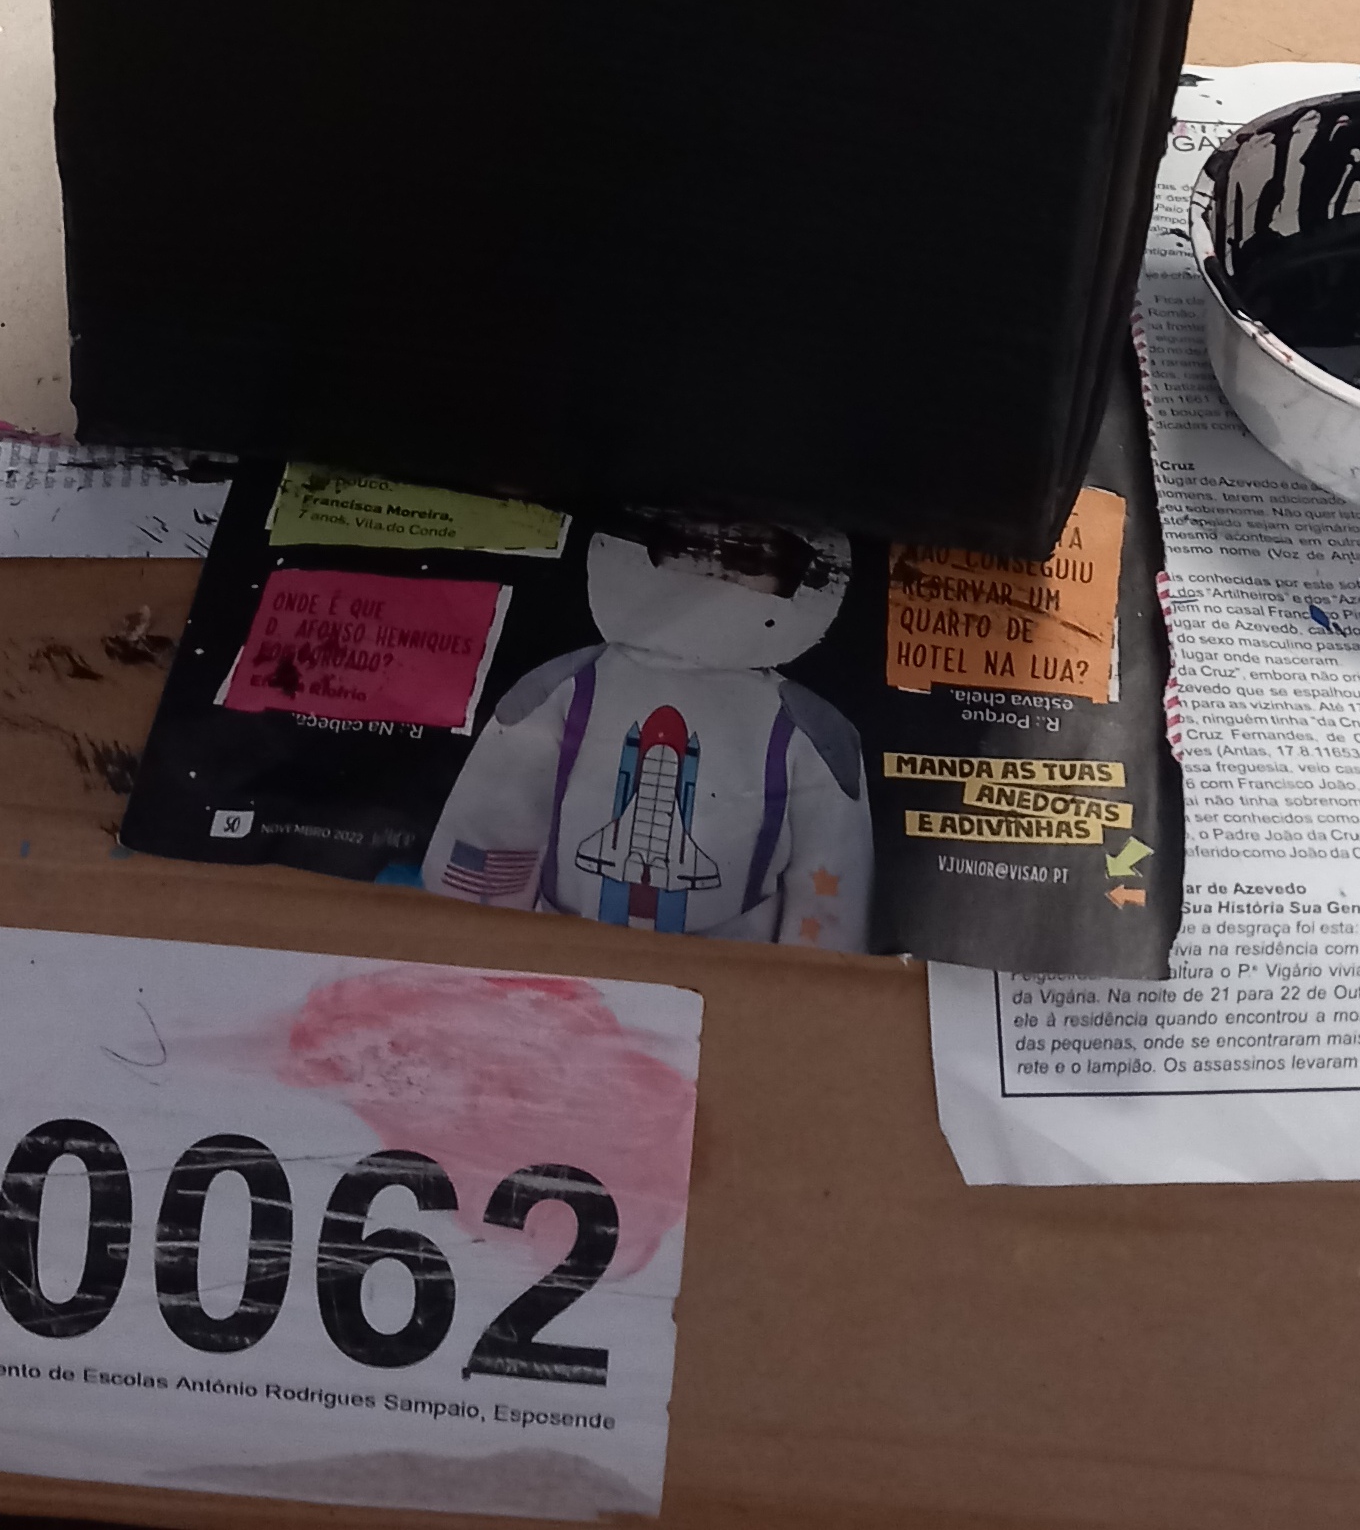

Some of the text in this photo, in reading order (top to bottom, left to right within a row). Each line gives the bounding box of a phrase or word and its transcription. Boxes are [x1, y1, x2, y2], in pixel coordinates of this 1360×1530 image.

[1160, 460, 1195, 471] Cruz
[303, 494, 382, 514] Francisca
[299, 509, 307, 518] 7
[387, 522, 404, 533] do
[409, 524, 457, 538] Conde
[273, 592, 321, 615] ONDE
[350, 598, 387, 619] QUE
[1030, 586, 1060, 611] UM
[295, 620, 366, 643] AFONSO
[376, 624, 474, 655] HENRIQUES
[900, 607, 1034, 643] QUARTO DE
[897, 641, 1089, 684] HOTEL NA LUA?
[950, 689, 1073, 711] estava cheia.
[369, 721, 394, 735] Na
[962, 709, 1029, 729] Porque
[896, 755, 1112, 782] MANDA AS TUAS
[975, 784, 1120, 822] ANEDOTAS
[918, 813, 1091, 839] E ADIVINHAS
[1207, 882, 1229, 895] de
[1233, 882, 1307, 895] Azevedo
[1217, 900, 1286, 916] História
[1289, 901, 1323, 915] Sua
[1016, 1036, 1045, 1051] das
[1144, 1035, 1184, 1049] onde
[1191, 1037, 1210, 1048] se
[1216, 1033, 1320, 1048] encontraram
[1017, 1060, 1049, 1074] rete
[1055, 1062, 1065, 1074] e
[1071, 1061, 1081, 1074] o
[1087, 1059, 1156, 1077] lampião.
[1164, 1057, 1187, 1072] Os
[1193, 1056, 1285, 1070] assassinos
[1292, 1055, 1358, 1069] levaram
[49, 1363, 74, 1380] de
[83, 1367, 168, 1390] Escolas
[176, 1375, 258, 1398] António
[265, 1384, 376, 1408] Rodrigues
[384, 1394, 485, 1421] Sampaio,
[494, 1404, 616, 1430] Esposende
